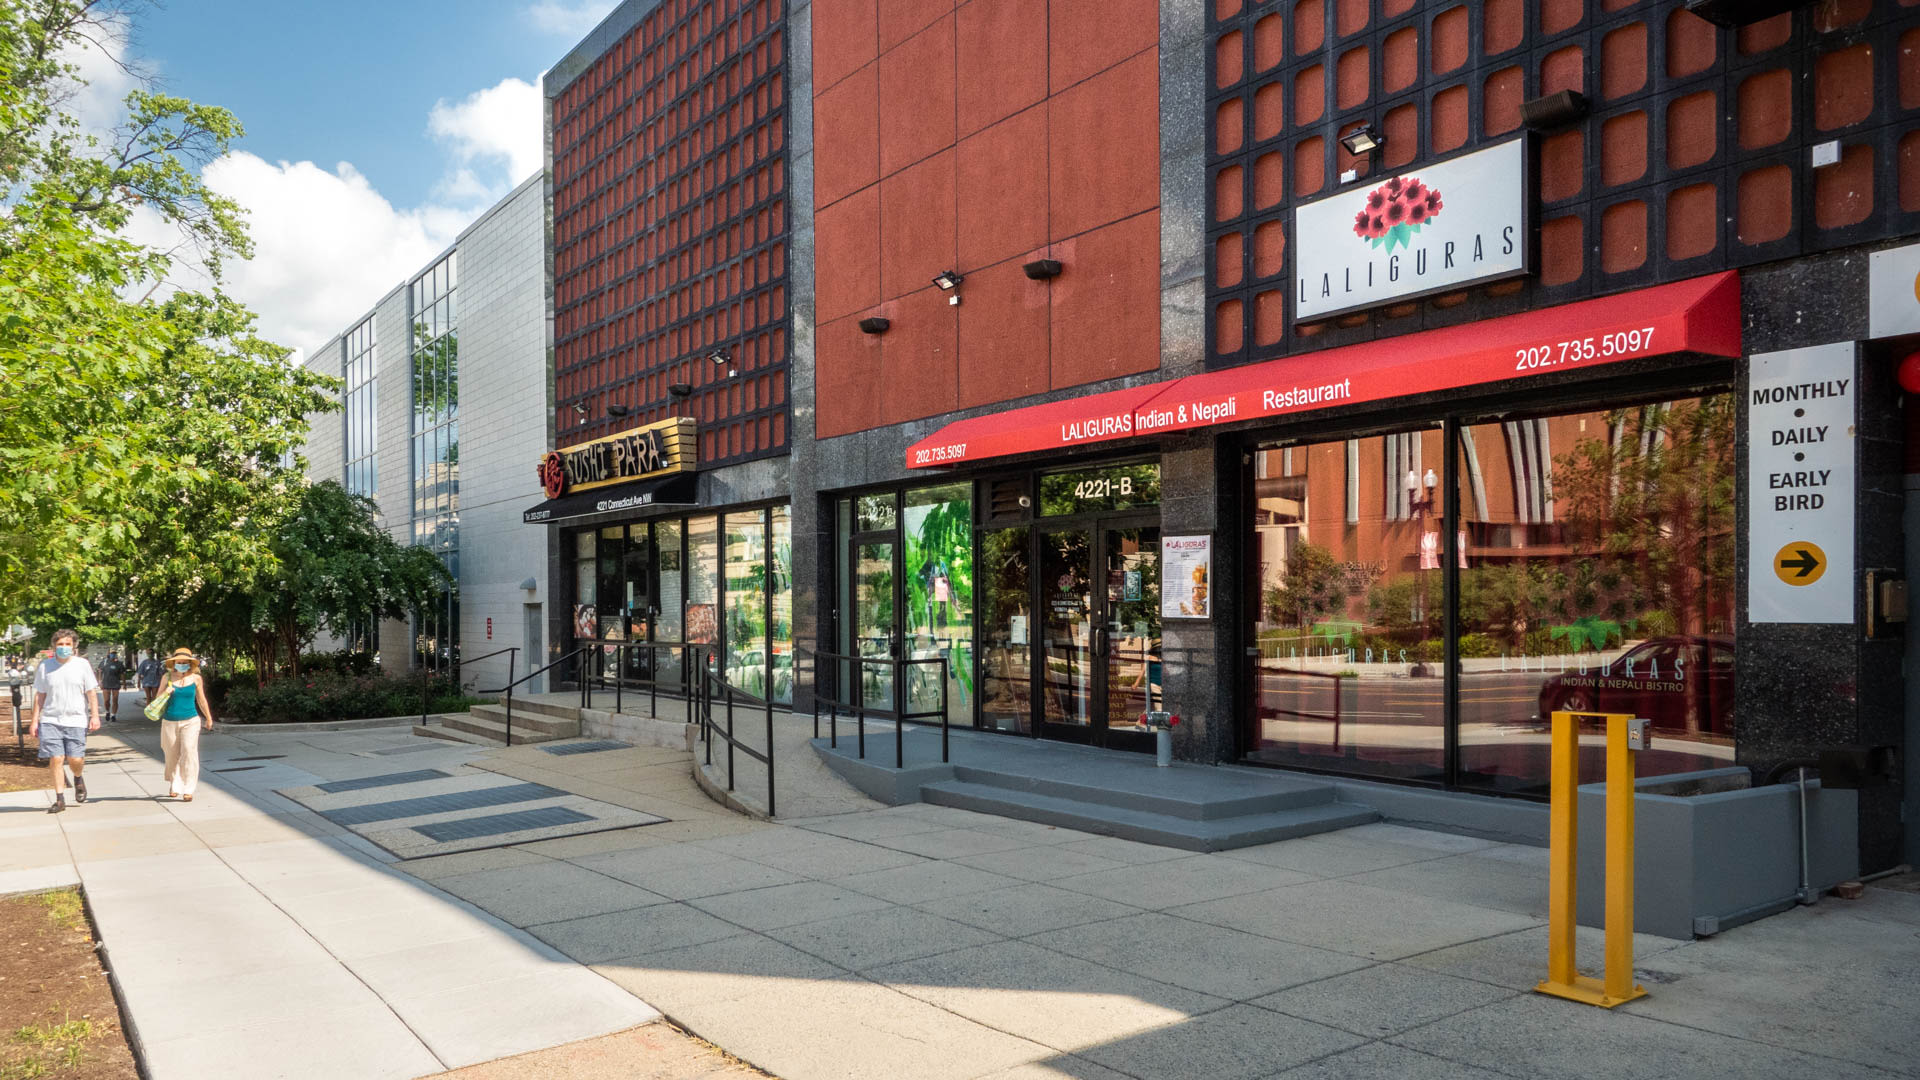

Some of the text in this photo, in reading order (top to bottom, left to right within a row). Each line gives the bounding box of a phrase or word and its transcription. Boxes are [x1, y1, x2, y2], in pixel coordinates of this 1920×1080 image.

[1300, 226, 1514, 304] LALIGURAS
[1515, 326, 1655, 371] 202.735.5097
[1753, 378, 1849, 405] MONTHLY
[1062, 378, 1351, 441] LALIGURAS Indian & Nepali Restaurant
[1772, 425, 1828, 446] DAILY
[566, 429, 661, 486] SUSHI PARA
[916, 443, 967, 464] 202.735.5097
[1074, 477, 1132, 499] 4221-B
[1769, 469, 1832, 489] EARLY
[596, 493, 653, 511] 4221 Connecticut Ave NW
[1775, 493, 1824, 511] BIRD
[1501, 652, 1684, 681] LALIGURAS
[1560, 677, 1685, 692] INDIAN & NEPALI BISTRO
